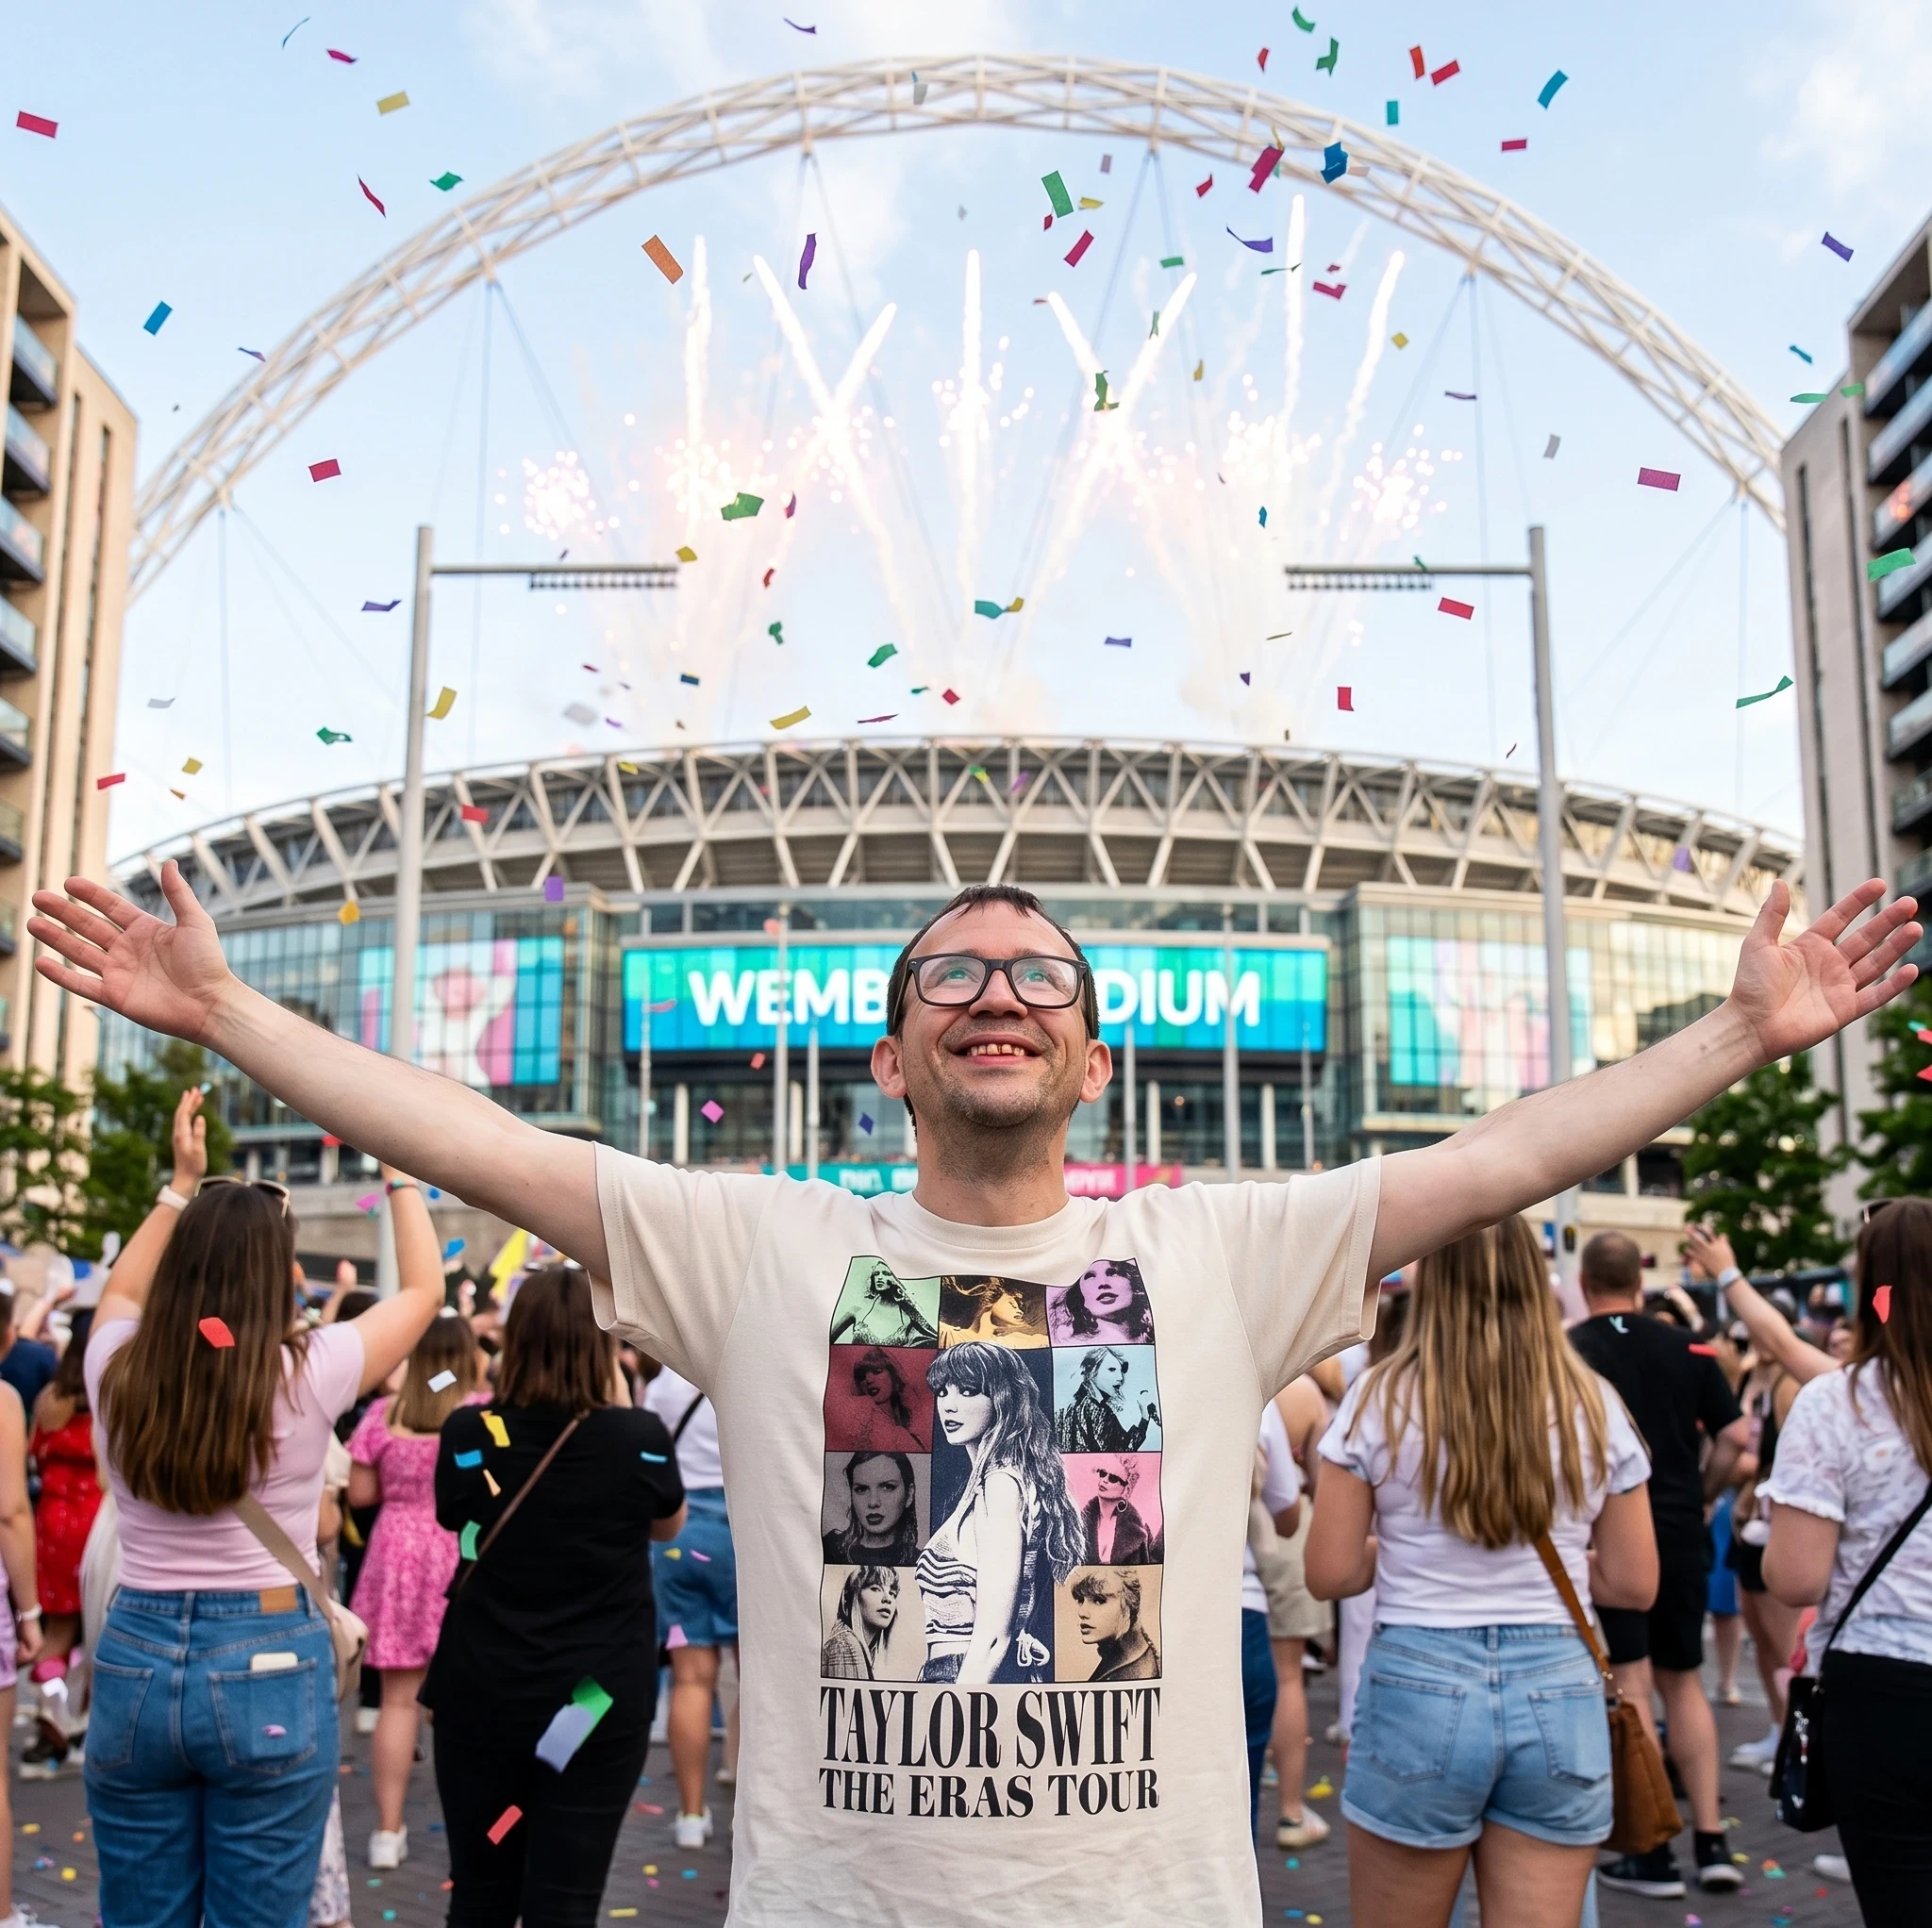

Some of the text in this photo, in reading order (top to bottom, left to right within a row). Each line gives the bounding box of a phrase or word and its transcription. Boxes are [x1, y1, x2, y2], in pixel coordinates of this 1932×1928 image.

[688, 969, 1260, 1026] WEMB DIUM
[819, 1686, 1161, 1770] TAYLOR SWIFT
[818, 1767, 1160, 1819] THE ERAS TOUR
